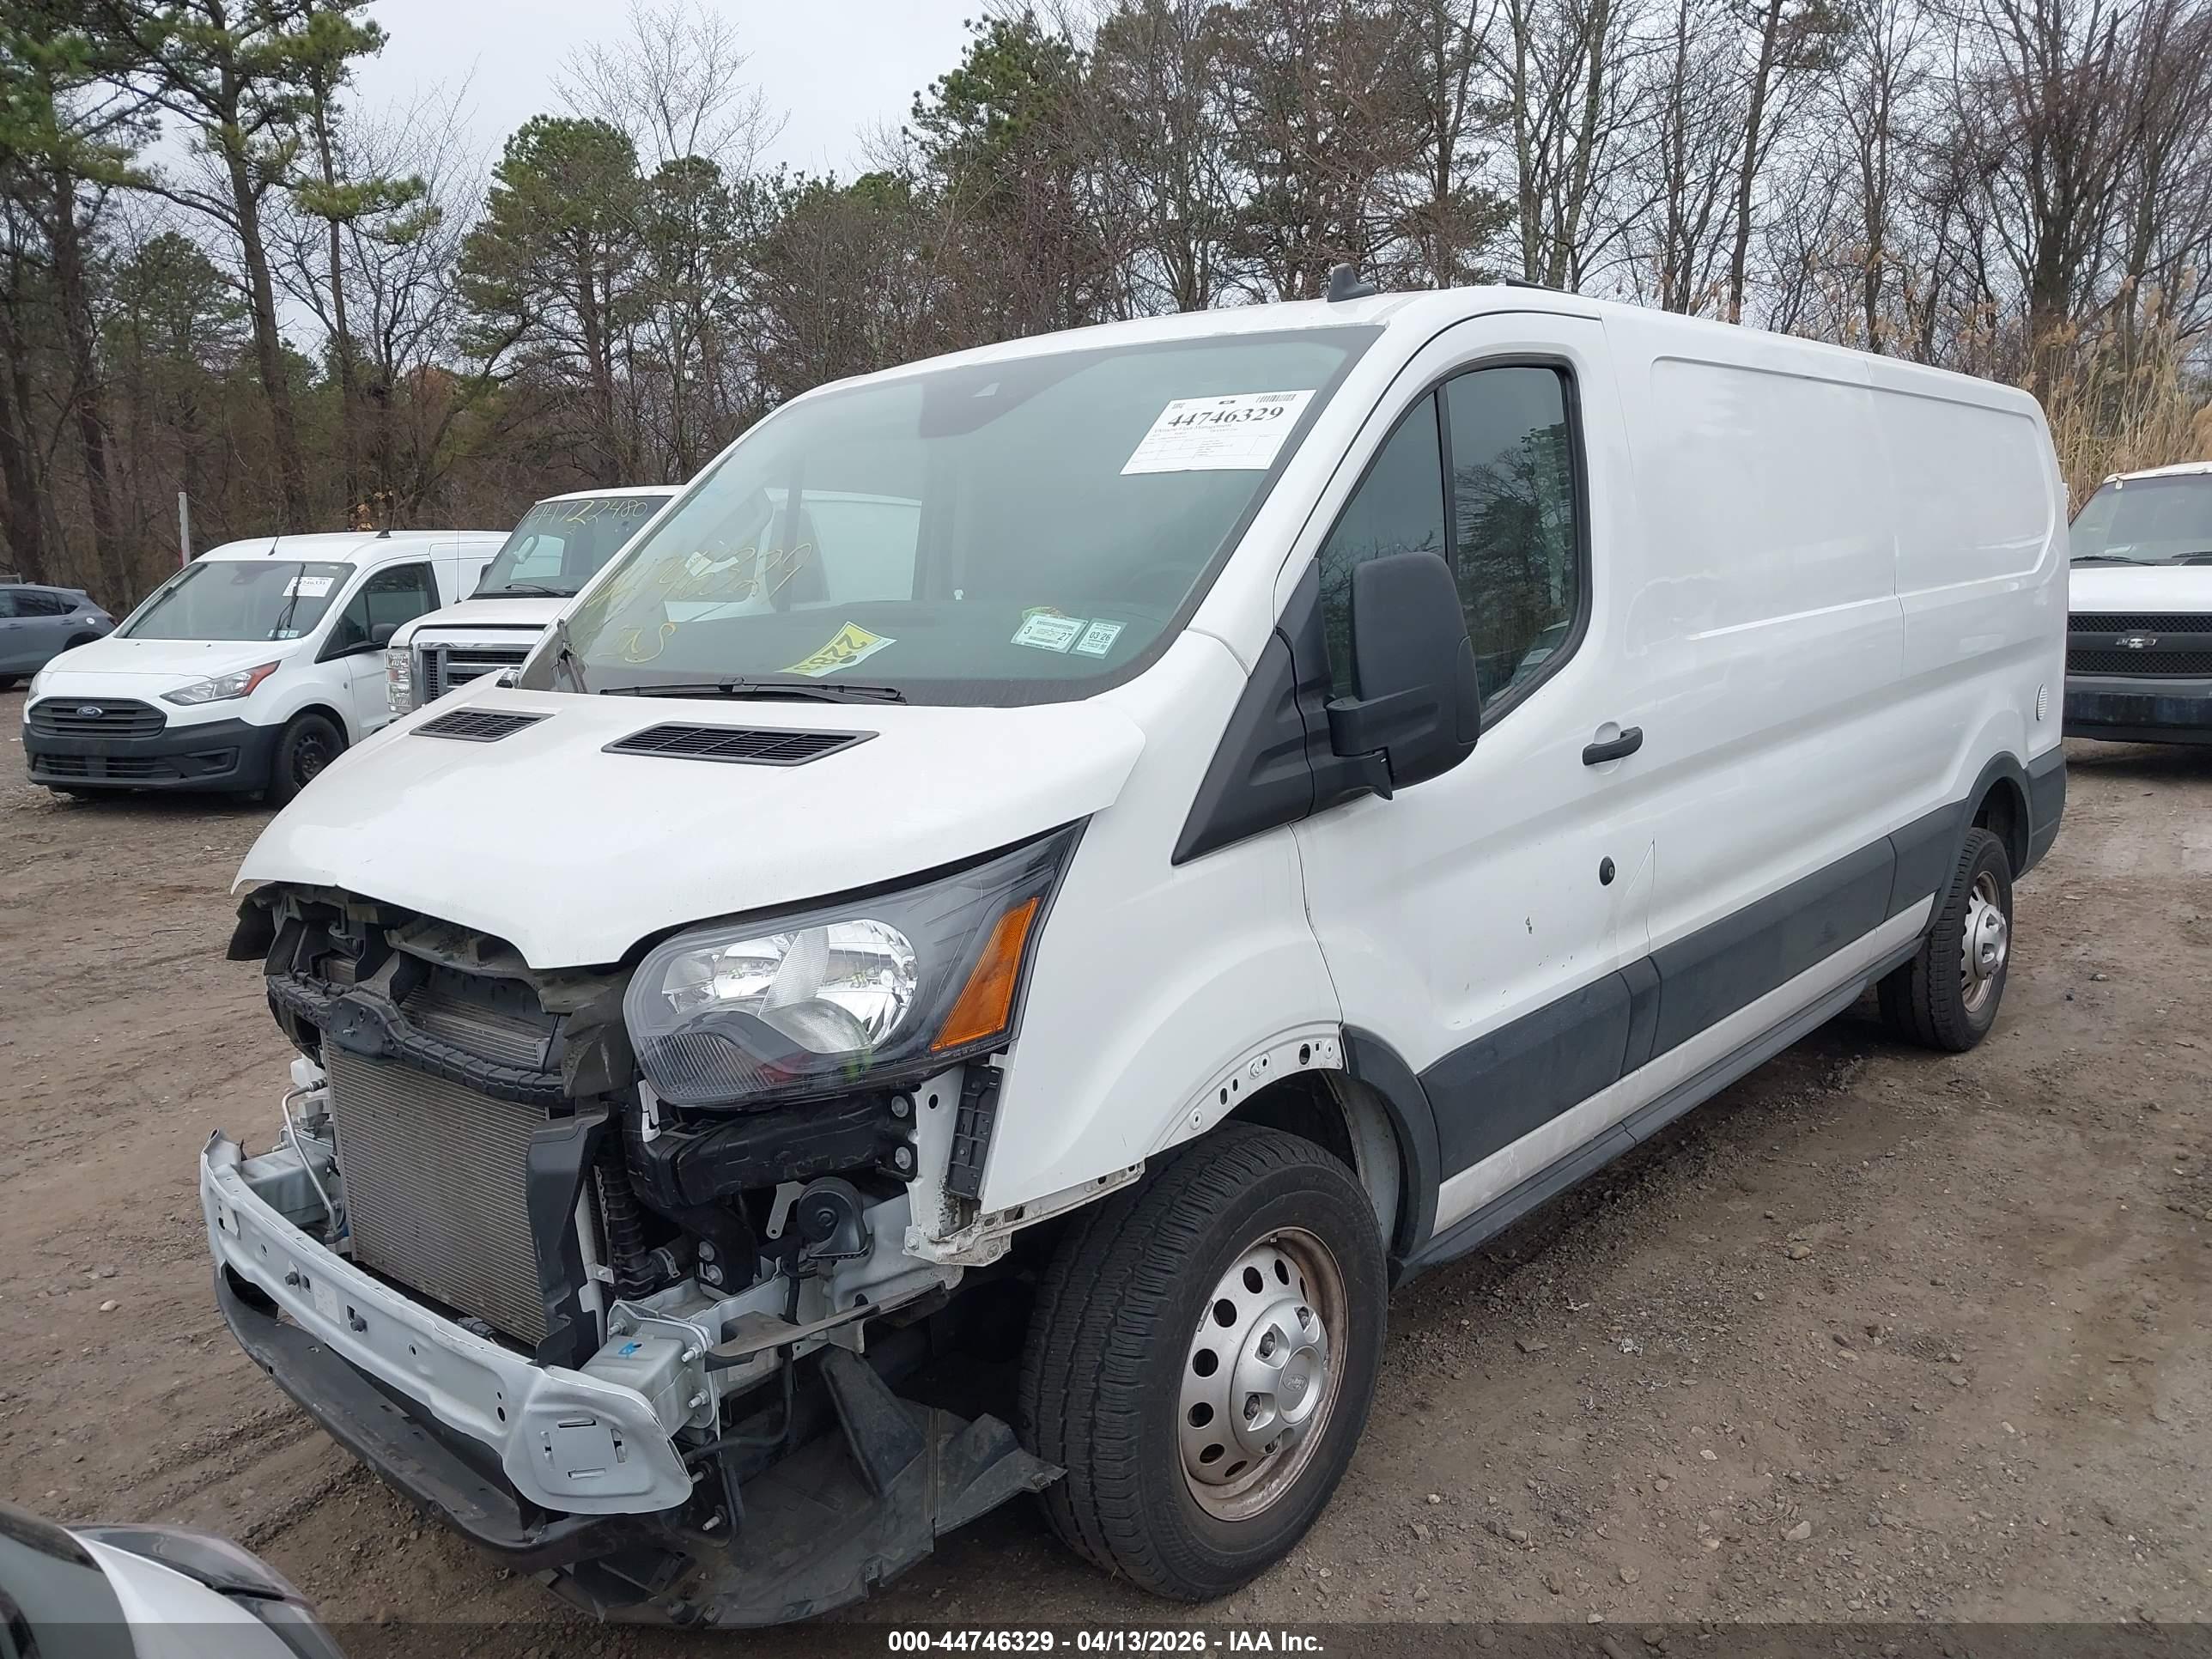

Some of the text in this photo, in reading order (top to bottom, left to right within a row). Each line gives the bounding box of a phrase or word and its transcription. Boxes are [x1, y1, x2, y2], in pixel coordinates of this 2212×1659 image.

[1168, 406, 1285, 428] 44746329
[1024, 626, 1032, 635] 3
[1057, 632, 1073, 641] 27
